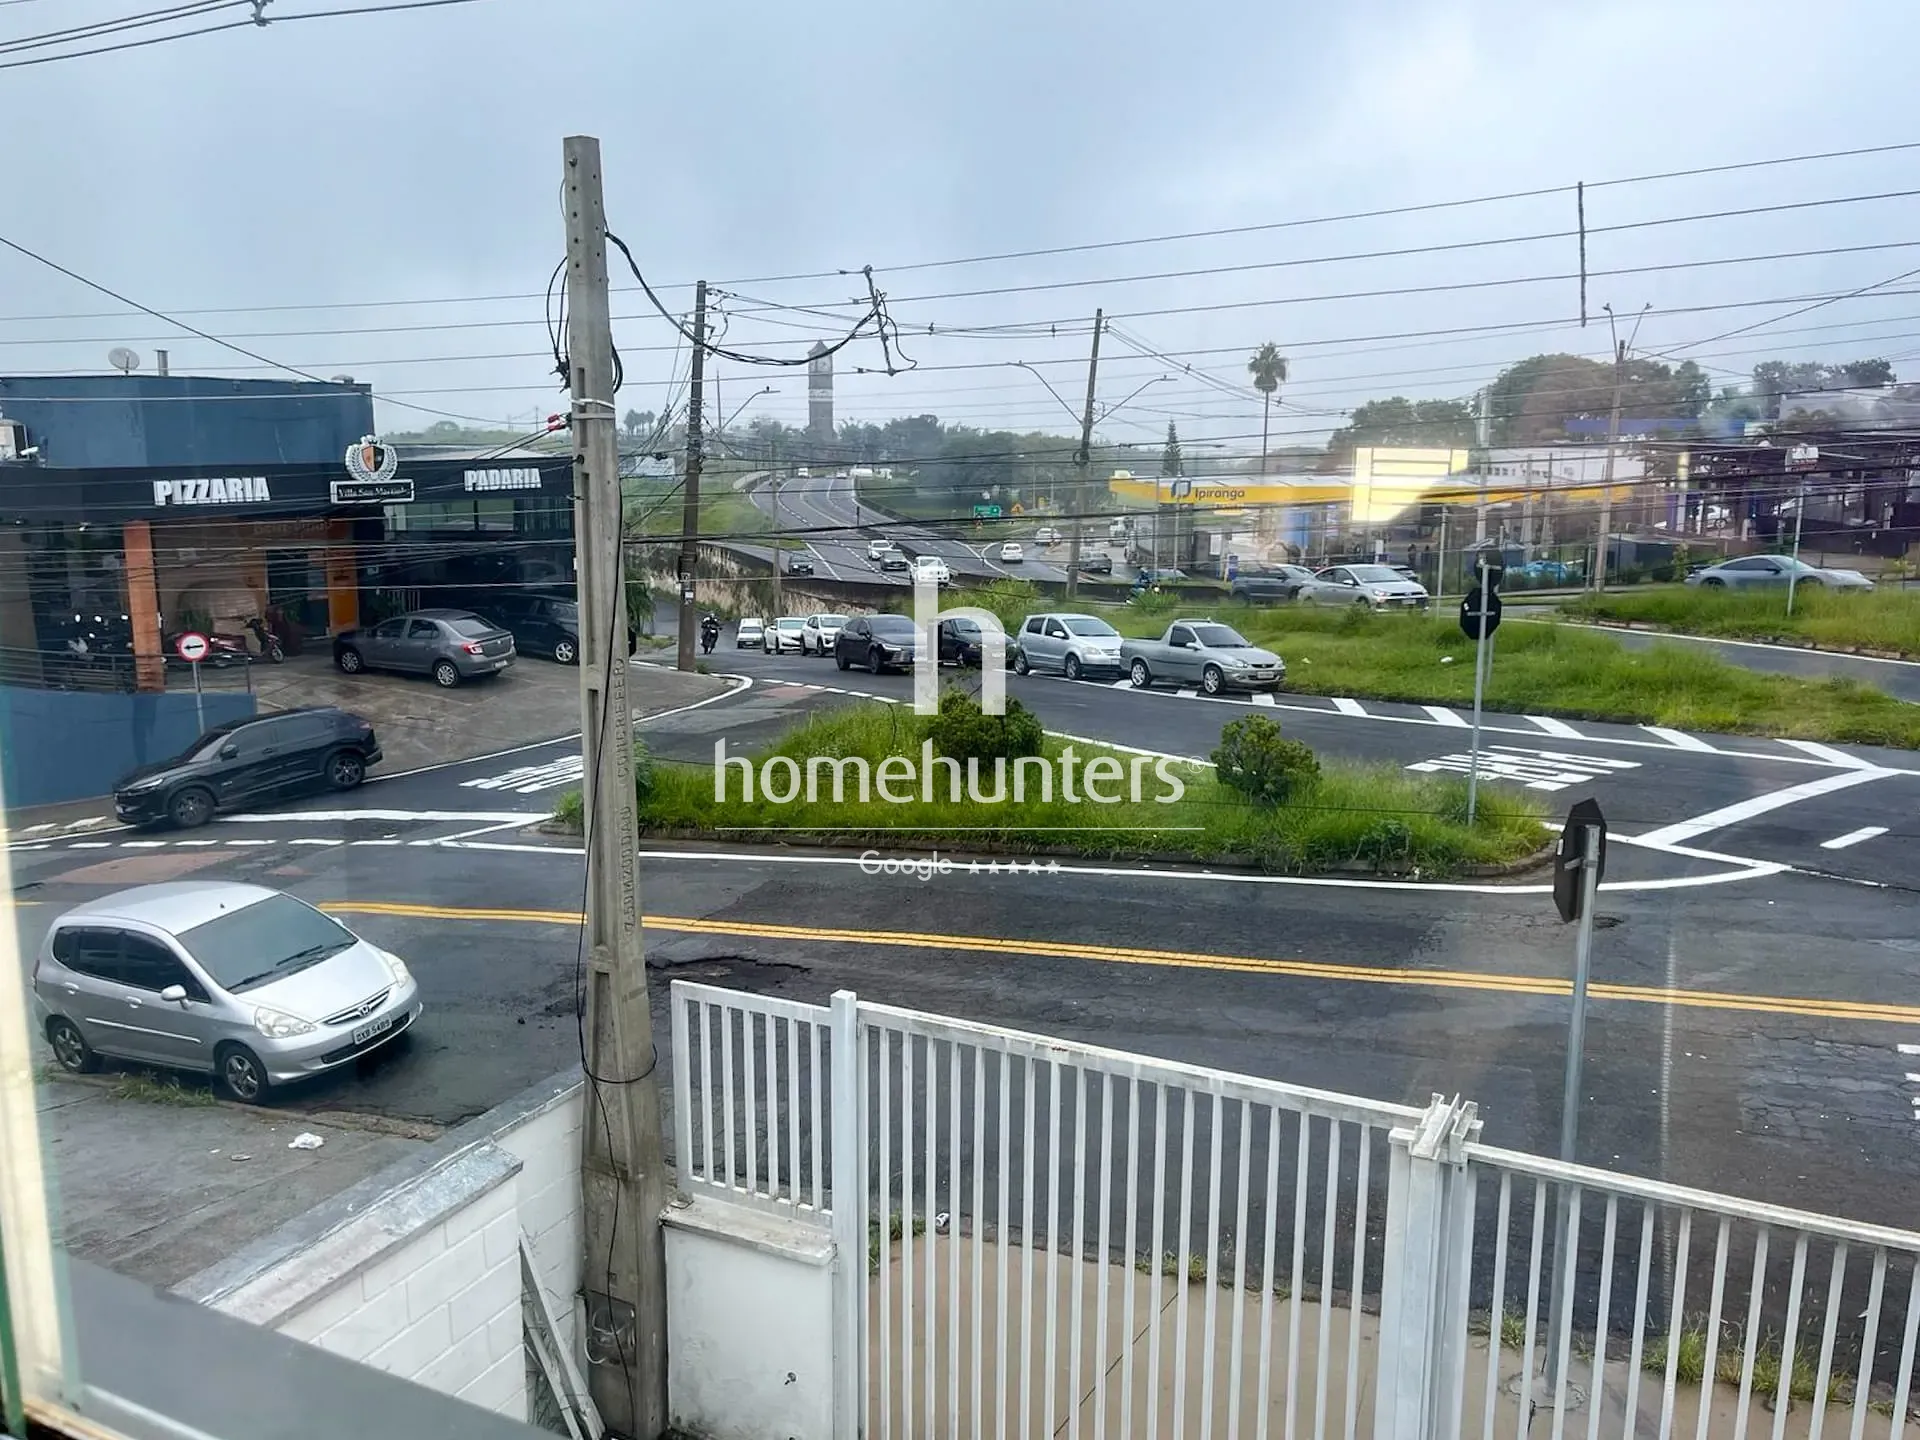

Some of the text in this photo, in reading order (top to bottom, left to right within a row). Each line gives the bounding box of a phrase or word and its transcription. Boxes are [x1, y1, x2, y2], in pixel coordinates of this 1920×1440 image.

[153, 477, 271, 505] PIZZARIA
[464, 468, 541, 491] PADARIA
[1195, 487, 1245, 500] Ipiranga
